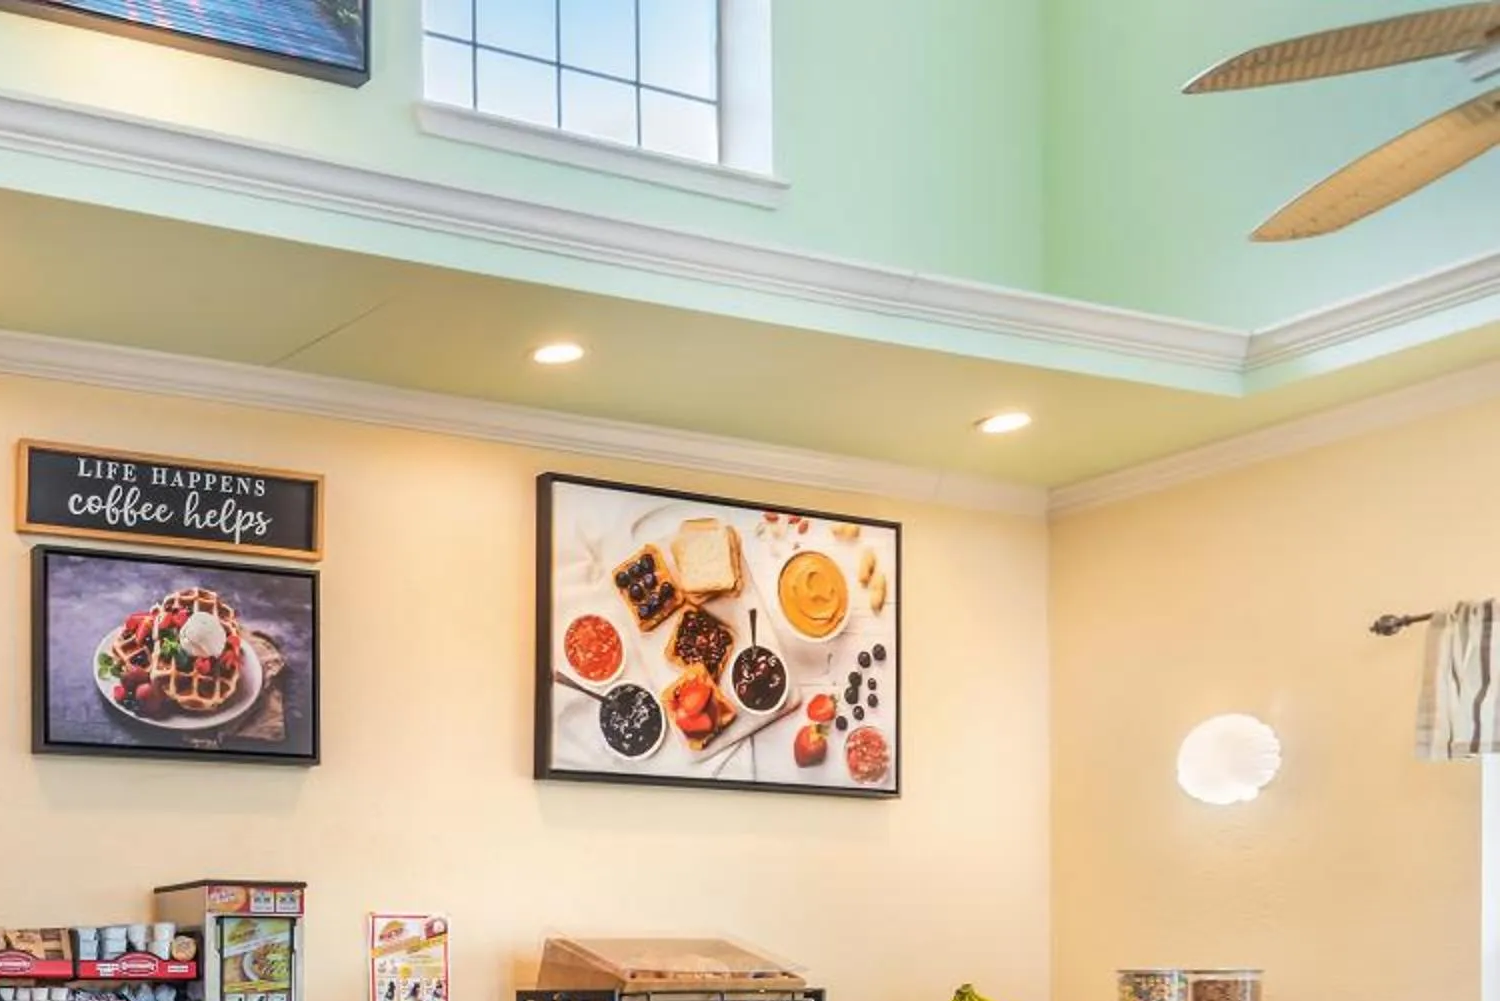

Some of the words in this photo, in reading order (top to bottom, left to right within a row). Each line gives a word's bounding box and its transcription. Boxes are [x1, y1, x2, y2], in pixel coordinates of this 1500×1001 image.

[77, 457, 137, 482] LIFE
[152, 467, 266, 497] HAPPENS
[68, 484, 175, 527] coffee
[184, 491, 273, 545] helps
